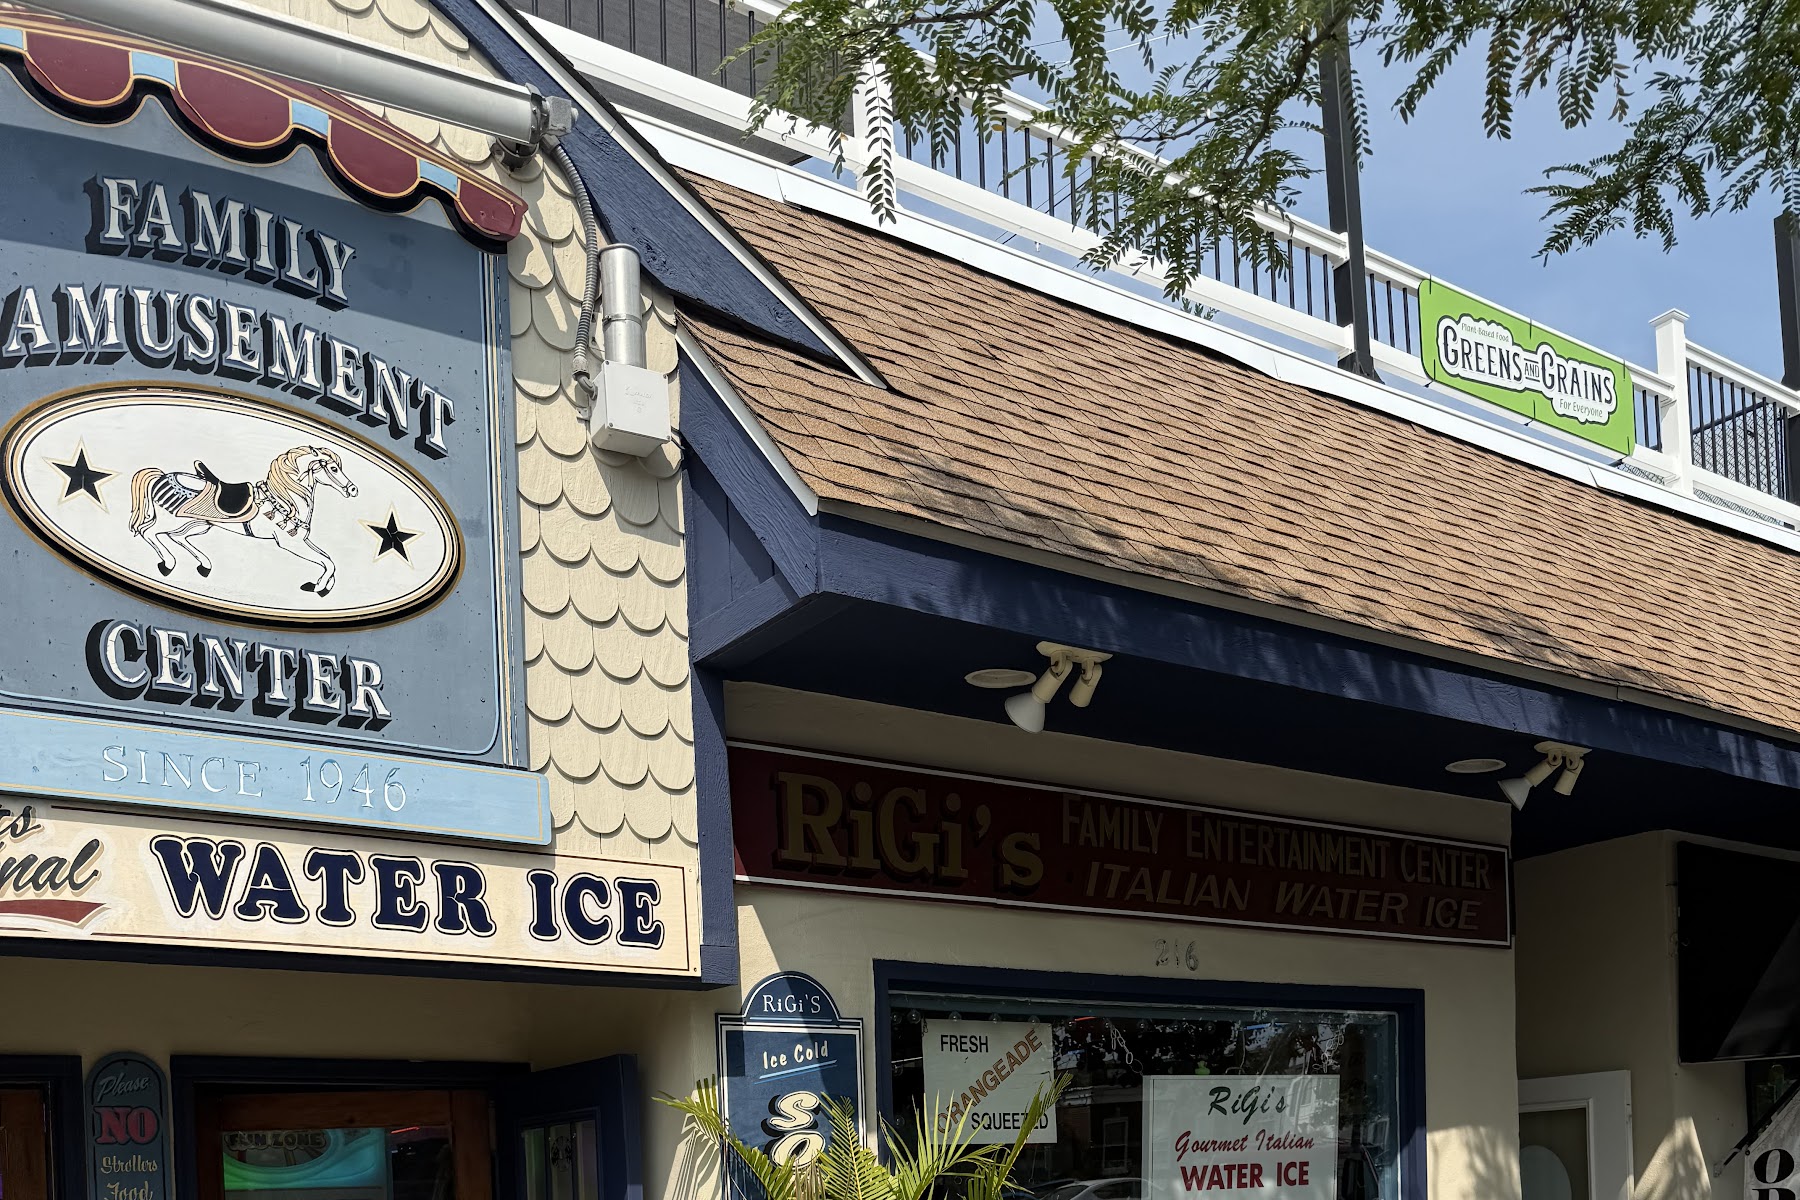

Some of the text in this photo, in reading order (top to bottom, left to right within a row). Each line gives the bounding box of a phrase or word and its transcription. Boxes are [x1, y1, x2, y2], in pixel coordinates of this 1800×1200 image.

[92, 174, 356, 307] FAMILY
[1496, 331, 1510, 343] Food
[0, 282, 456, 457] AMUSEMENT
[1442, 325, 1613, 405] GREENS AND GRAINS
[1559, 399, 1604, 419] For Everyone
[92, 619, 392, 727] CENTER
[102, 745, 407, 812] SINCE 1946
[776, 770, 1492, 892] RiGi's FAMILY ENTERTAINMENT CENTER
[0, 834, 664, 952] nal WATER ICE
[1086, 861, 1482, 932] ITALIAN WATER ICE
[1155, 938, 1199, 972] 216
[763, 1040, 829, 1070] Ice Cold
[940, 1034, 989, 1053] FRESH
[97, 1073, 150, 1103] Please
[937, 1028, 1043, 1134] ORANGEADE
[971, 1112, 1049, 1130] SQUEED
[1208, 1086, 1287, 1125] RiGi's
[93, 1106, 159, 1145] NO
[101, 1155, 158, 1174] Strollers
[1175, 1129, 1315, 1162] Gourmet Italian
[1180, 1161, 1310, 1191] WATER ICE
